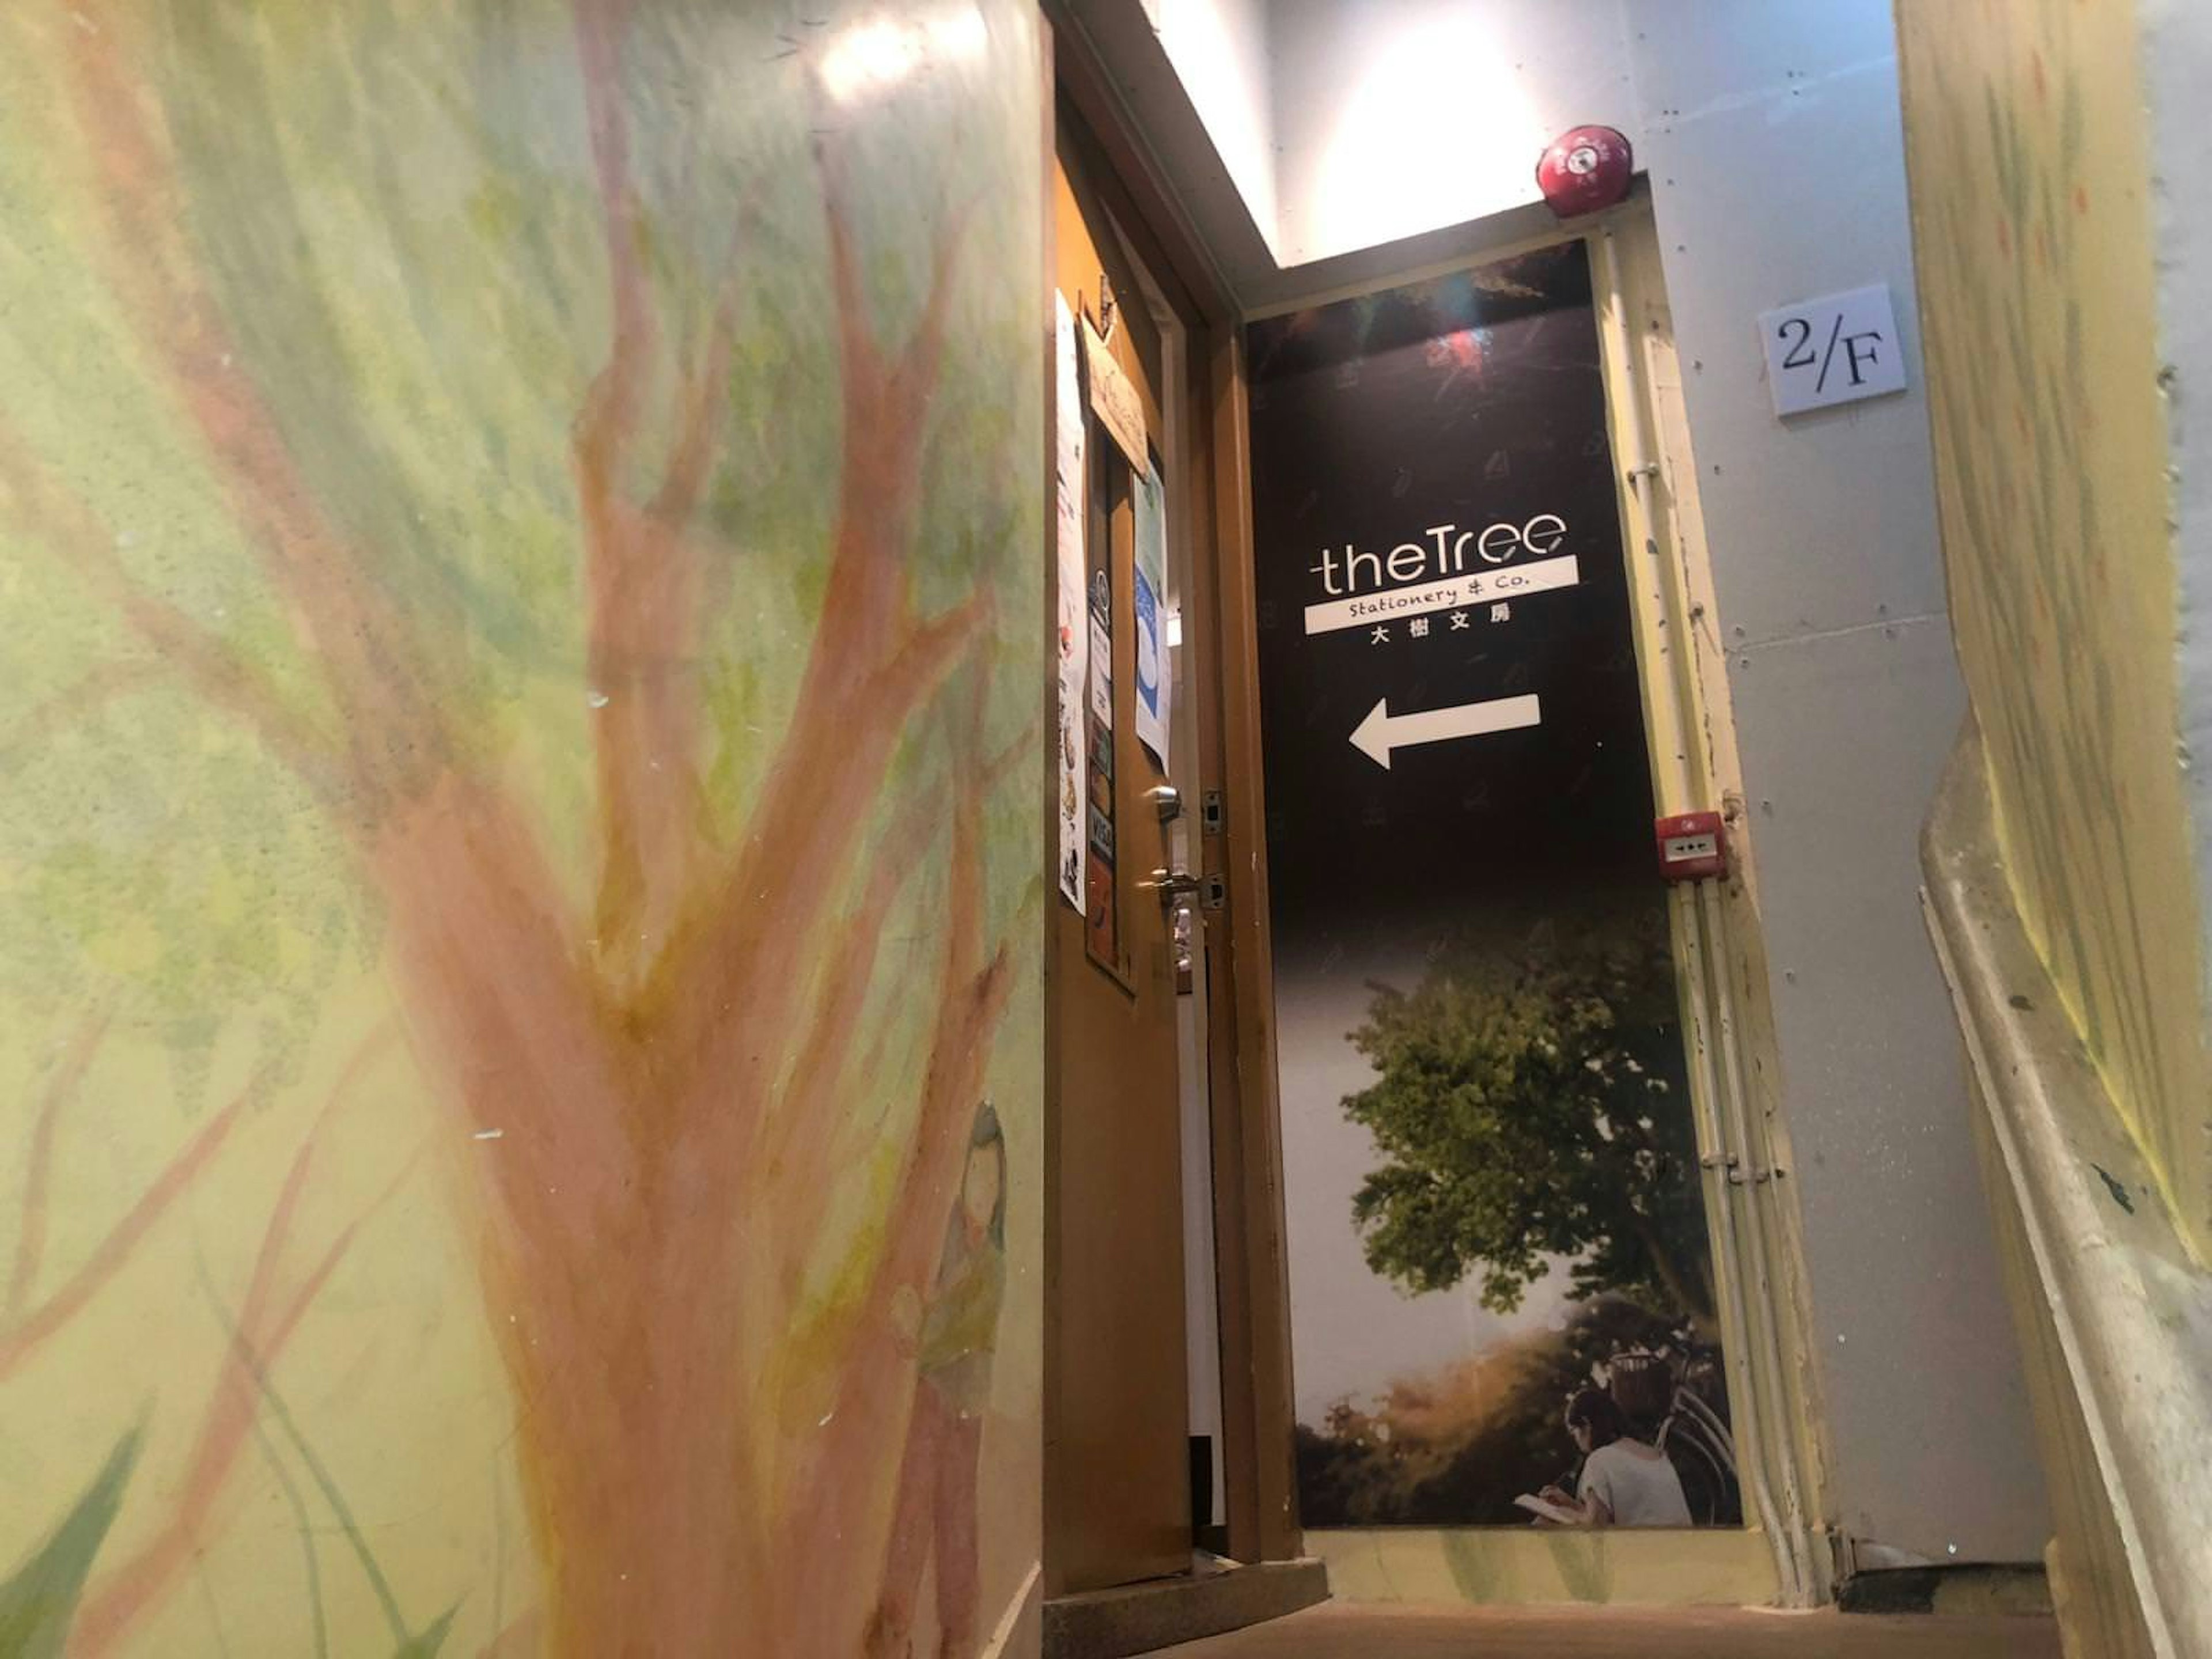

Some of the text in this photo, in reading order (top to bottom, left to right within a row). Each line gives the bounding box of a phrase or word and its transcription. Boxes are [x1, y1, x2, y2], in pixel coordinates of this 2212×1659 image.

[1778, 313, 1883, 393] 2/F
[1309, 514, 1567, 594] theTree
[1349, 575, 1531, 618] Stationery & Co.
[1370, 602, 1510, 645] 大樹文房
